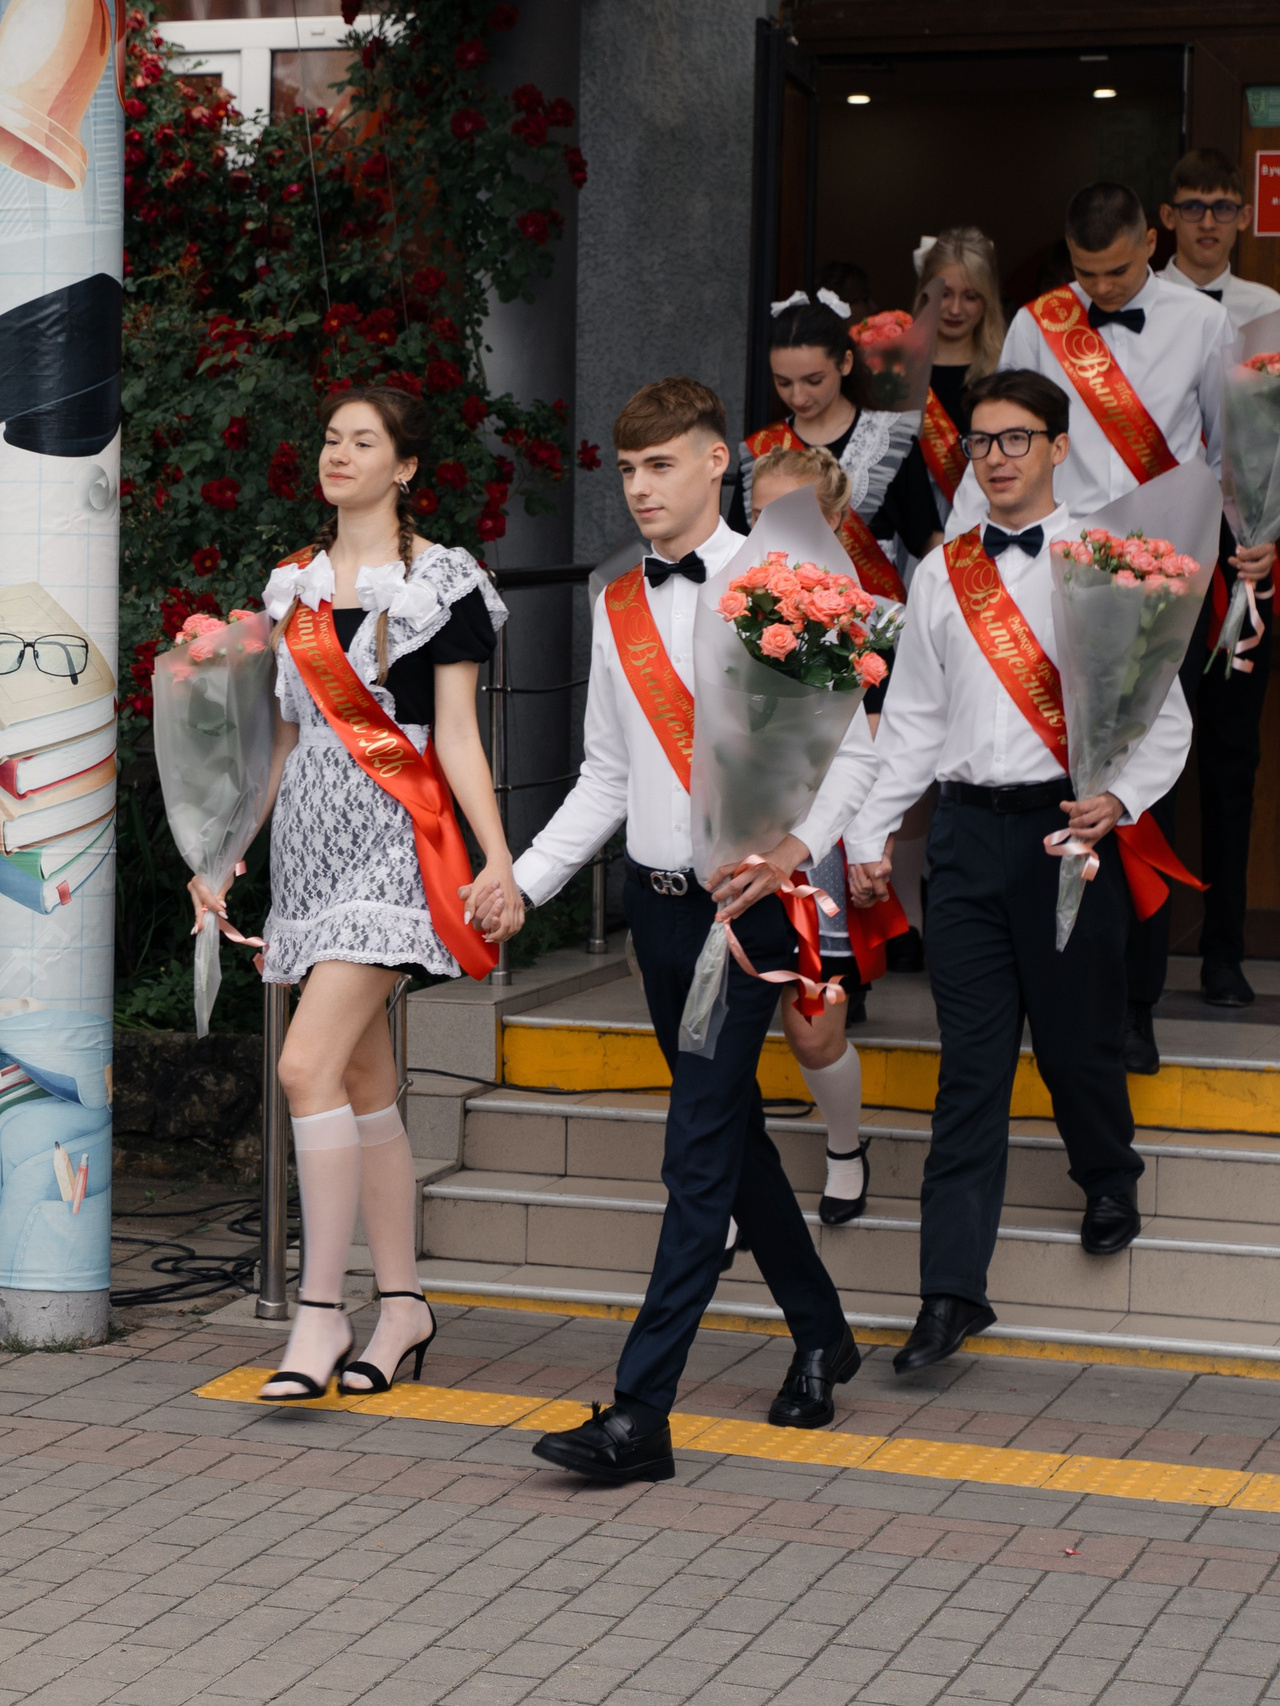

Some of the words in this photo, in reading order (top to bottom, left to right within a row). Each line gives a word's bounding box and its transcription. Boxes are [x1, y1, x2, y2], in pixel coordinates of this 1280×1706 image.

[290, 604, 367, 734] ыпускница
[356, 728, 415, 778] 2026
[341, 669, 371, 709] Мария
[621, 602, 693, 766] Выпускн
[963, 558, 1065, 728] Выпускник
